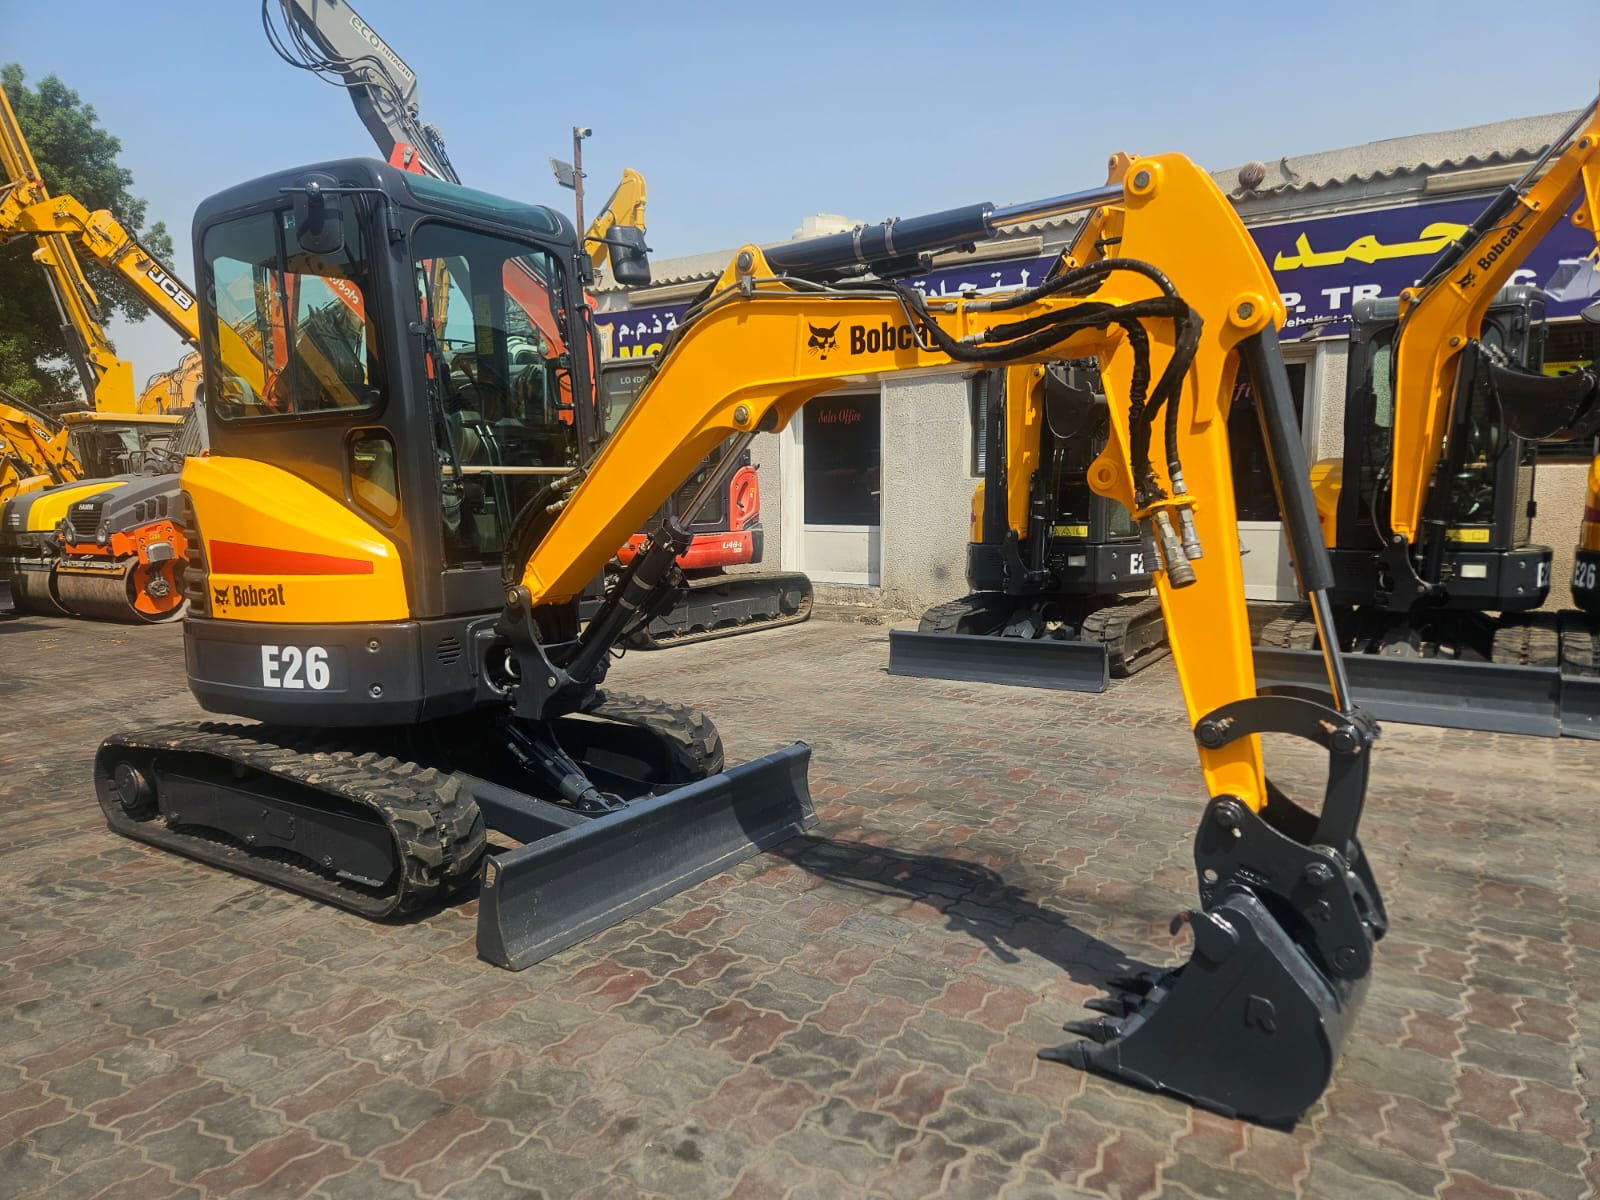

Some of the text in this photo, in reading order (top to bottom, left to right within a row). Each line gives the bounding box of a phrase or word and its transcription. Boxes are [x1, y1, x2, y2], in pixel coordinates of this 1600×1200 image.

[381, 46, 412, 79] HITACHI
[1477, 221, 1525, 272] Bobcat
[147, 265, 193, 311] JCB
[849, 316, 942, 356] Bobcat
[233, 583, 286, 608] Bobcat
[260, 644, 331, 691] E26
